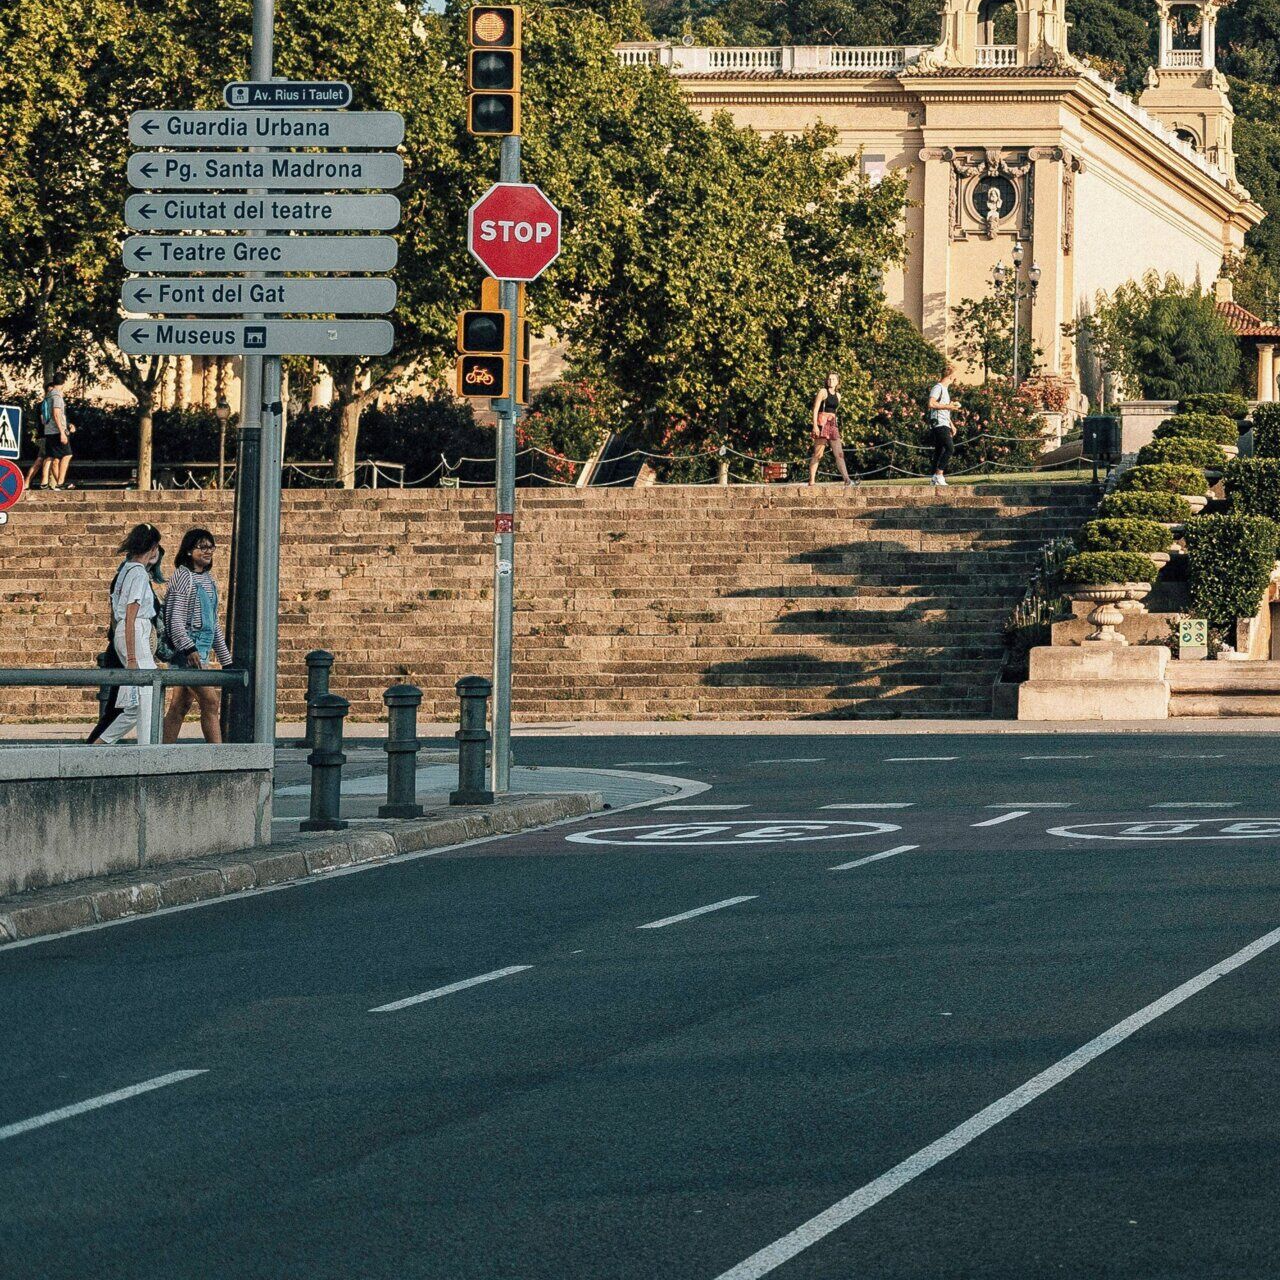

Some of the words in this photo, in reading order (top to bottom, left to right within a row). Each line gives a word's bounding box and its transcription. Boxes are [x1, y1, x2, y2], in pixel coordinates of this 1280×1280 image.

[254, 90, 271, 100] Av.
[275, 90, 299, 100] Rius
[303, 89, 306, 100] i
[309, 89, 343, 100] Taulet
[167, 116, 248, 136] Guardia
[256, 118, 330, 136] Urbana
[165, 159, 197, 182] Pg.
[205, 159, 264, 178] Santa
[272, 159, 362, 177] Madrona
[164, 200, 226, 219] Ciutat
[233, 201, 264, 219] del
[272, 202, 332, 219] teatre
[480, 220, 552, 243] STOP
[160, 242, 226, 261] Teatre
[233, 242, 281, 261] Grec
[159, 284, 204, 303] Font
[212, 284, 242, 303] del
[250, 284, 285, 303] Gat
[156, 325, 236, 344] Museus
